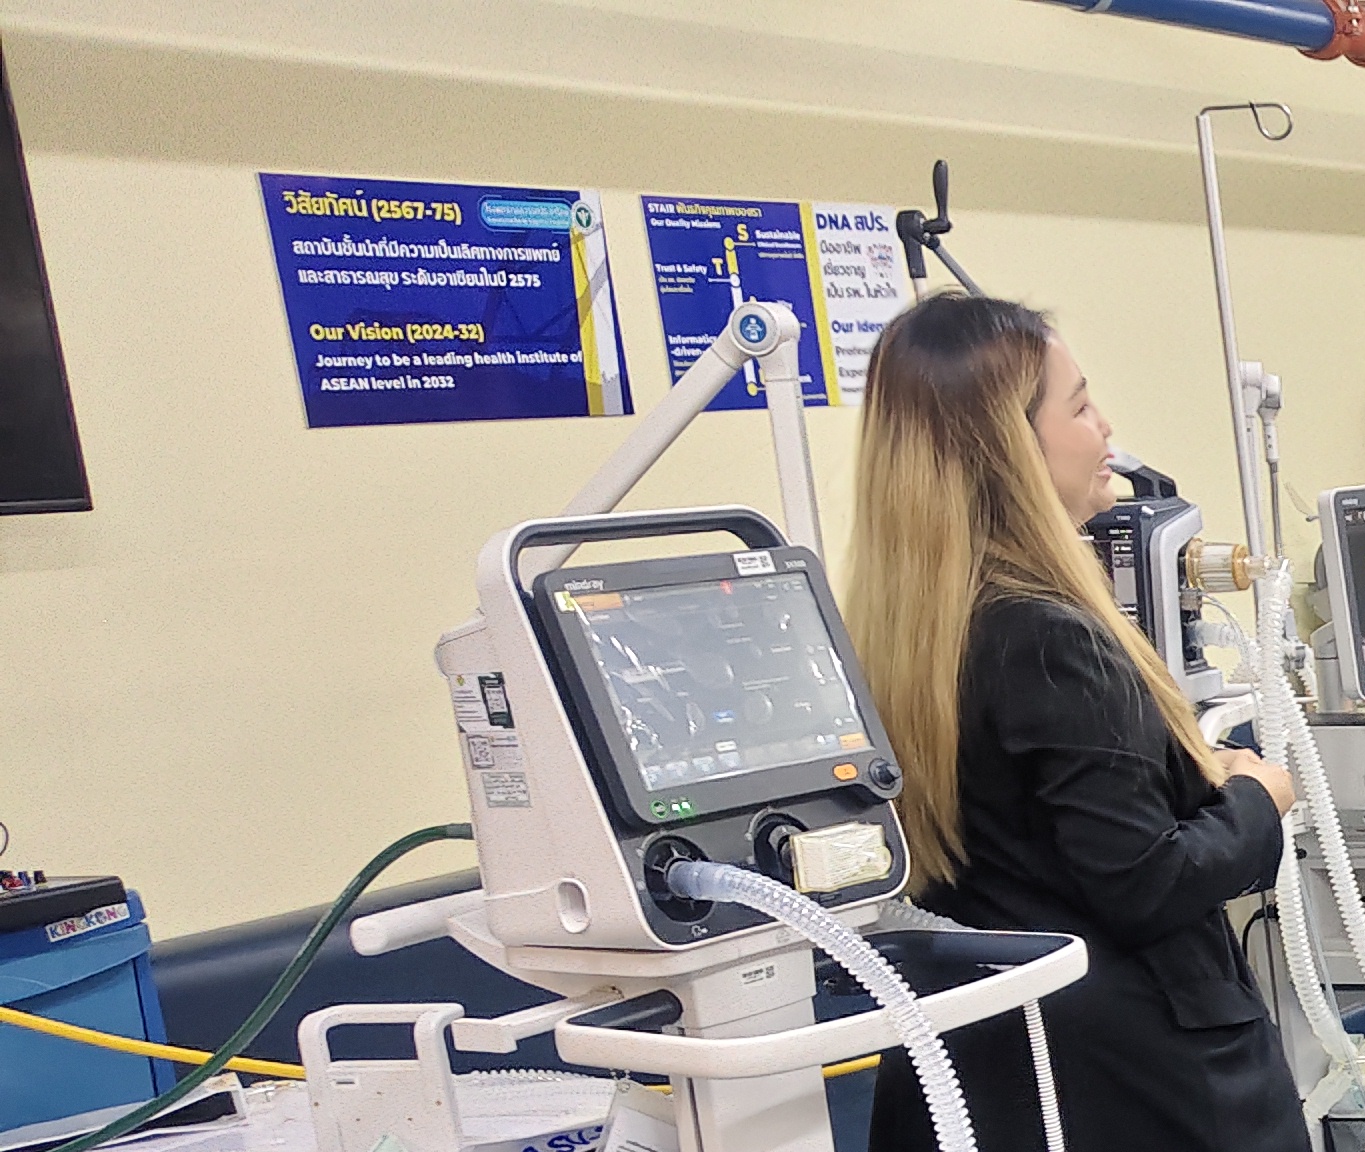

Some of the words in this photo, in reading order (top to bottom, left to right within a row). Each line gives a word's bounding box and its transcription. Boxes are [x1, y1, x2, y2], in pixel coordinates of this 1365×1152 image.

[282, 189, 369, 217] วิสัยทัศน์
[371, 198, 462, 225] (2567-75)
[816, 213, 852, 230] DNA
[854, 210, 889, 232] สปร.
[736, 223, 749, 241] S
[711, 257, 724, 276] T
[298, 269, 399, 290] และสาธารณสุข
[508, 273, 541, 287] 2575
[309, 323, 346, 341] Our
[348, 321, 405, 340] Vision
[406, 322, 485, 344] (2024-32)
[831, 319, 854, 333] Our
[315, 353, 374, 370] Journey
[376, 353, 391, 366] to
[393, 352, 411, 366] be
[413, 356, 422, 366] a
[423, 351, 474, 368] leading
[474, 350, 516, 365] health
[516, 350, 569, 363] institute
[570, 349, 583, 363] of
[320, 375, 371, 391] ASEAN
[371, 375, 405, 390] level
[406, 375, 422, 388] in
[423, 375, 456, 389] 2032
[563, 579, 604, 591] mindray
